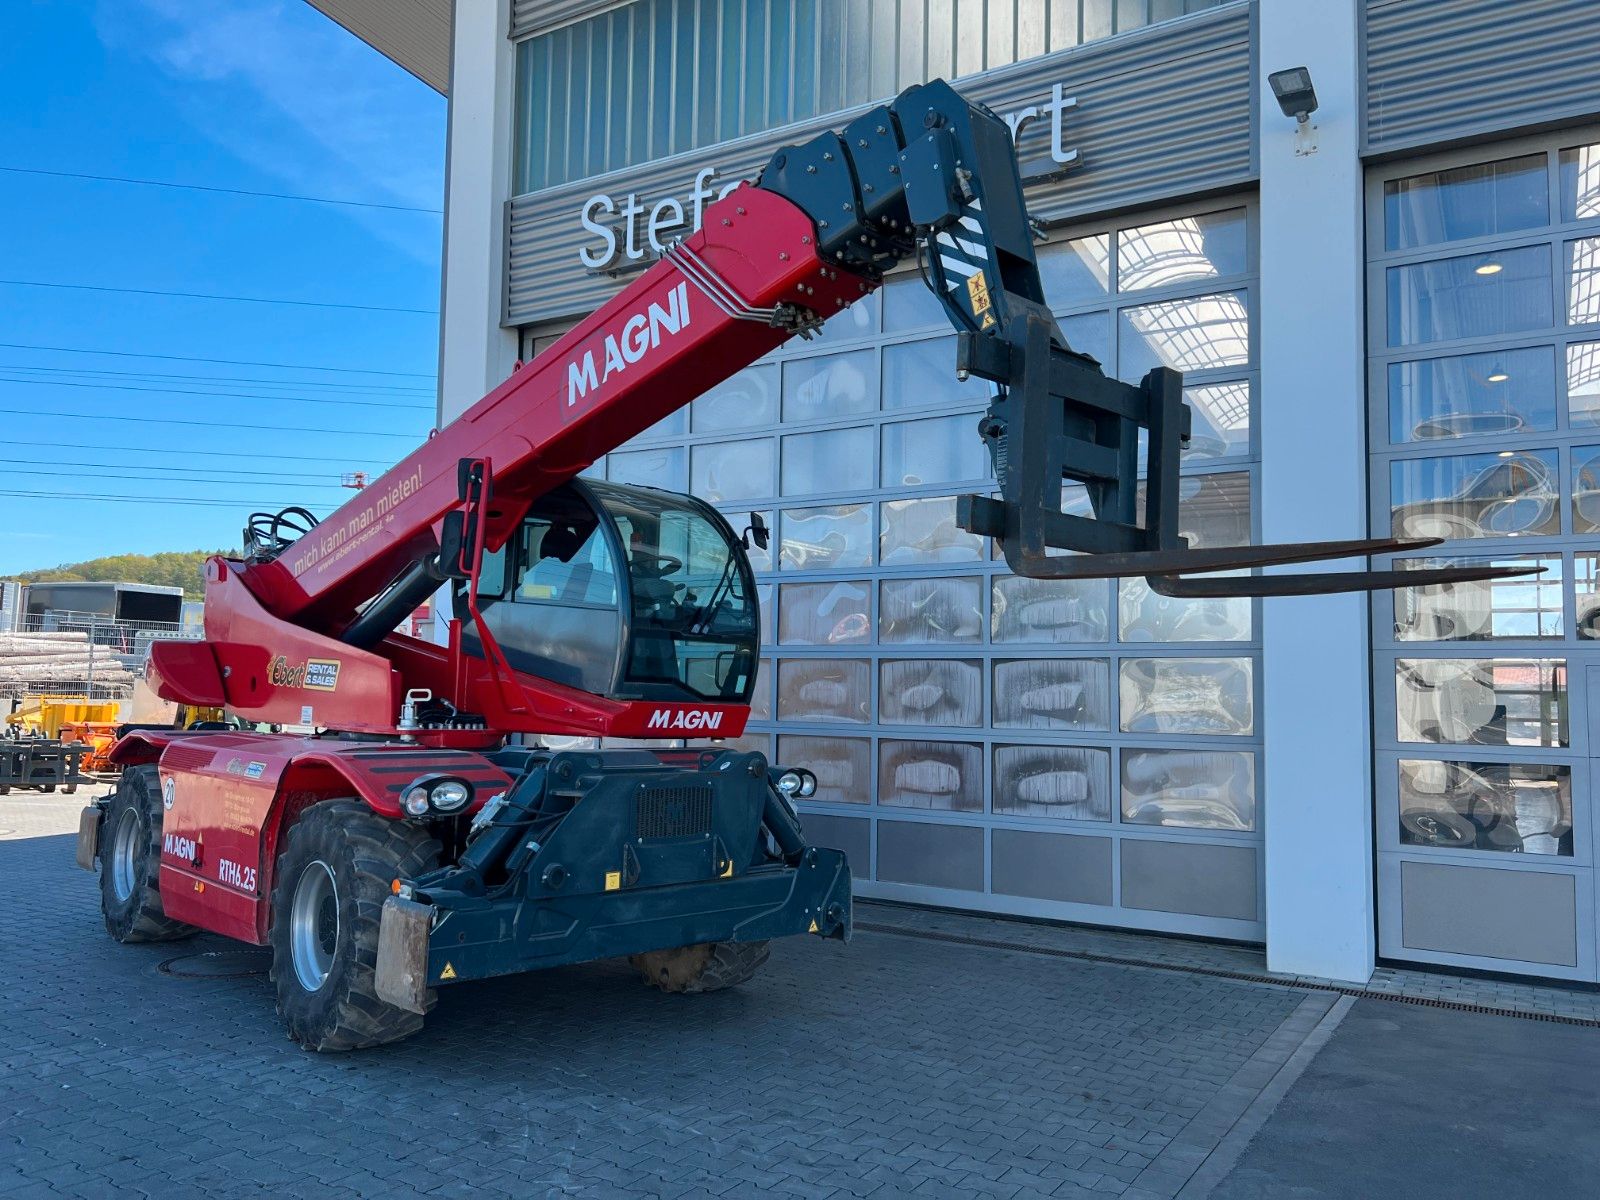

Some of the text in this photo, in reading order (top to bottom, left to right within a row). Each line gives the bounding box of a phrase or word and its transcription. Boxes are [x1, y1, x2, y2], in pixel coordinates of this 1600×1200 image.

[580, 83, 1077, 268] Stef rt
[568, 281, 690, 407] MAGNI
[294, 464, 423, 576] mich kann man mieten!
[307, 663, 337, 675] RENTAL
[311, 676, 336, 686] SALES
[647, 709, 724, 730] MAGNI
[165, 783, 174, 804] 20
[164, 833, 196, 861] MAGNI
[219, 858, 257, 892] RTH6.25
